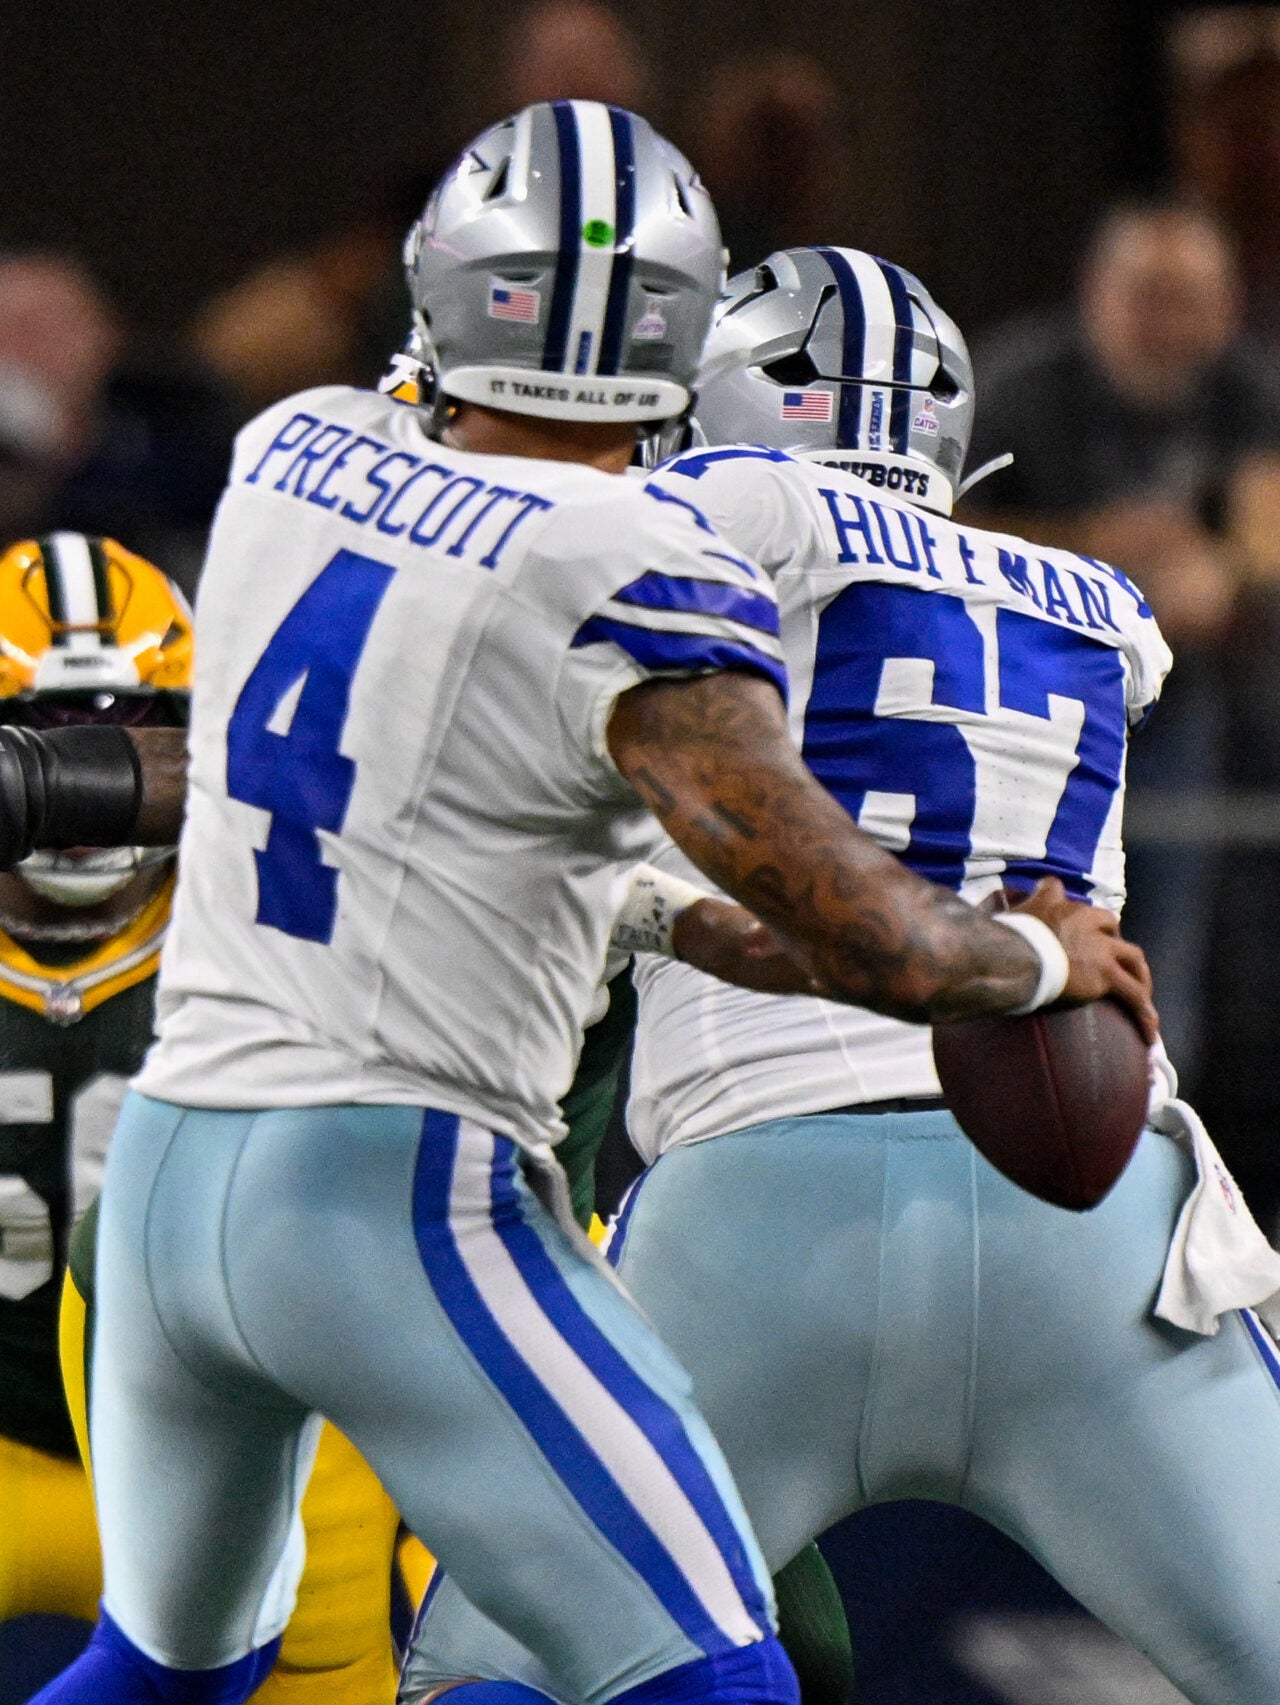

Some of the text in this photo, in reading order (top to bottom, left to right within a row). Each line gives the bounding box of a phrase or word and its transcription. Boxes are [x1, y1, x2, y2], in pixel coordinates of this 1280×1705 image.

[245, 412, 554, 570] PRESCOTT
[491, 380, 660, 407] IT TAKES ALL OF US
[227, 547, 397, 946] 4
[801, 580, 1126, 907] 67
